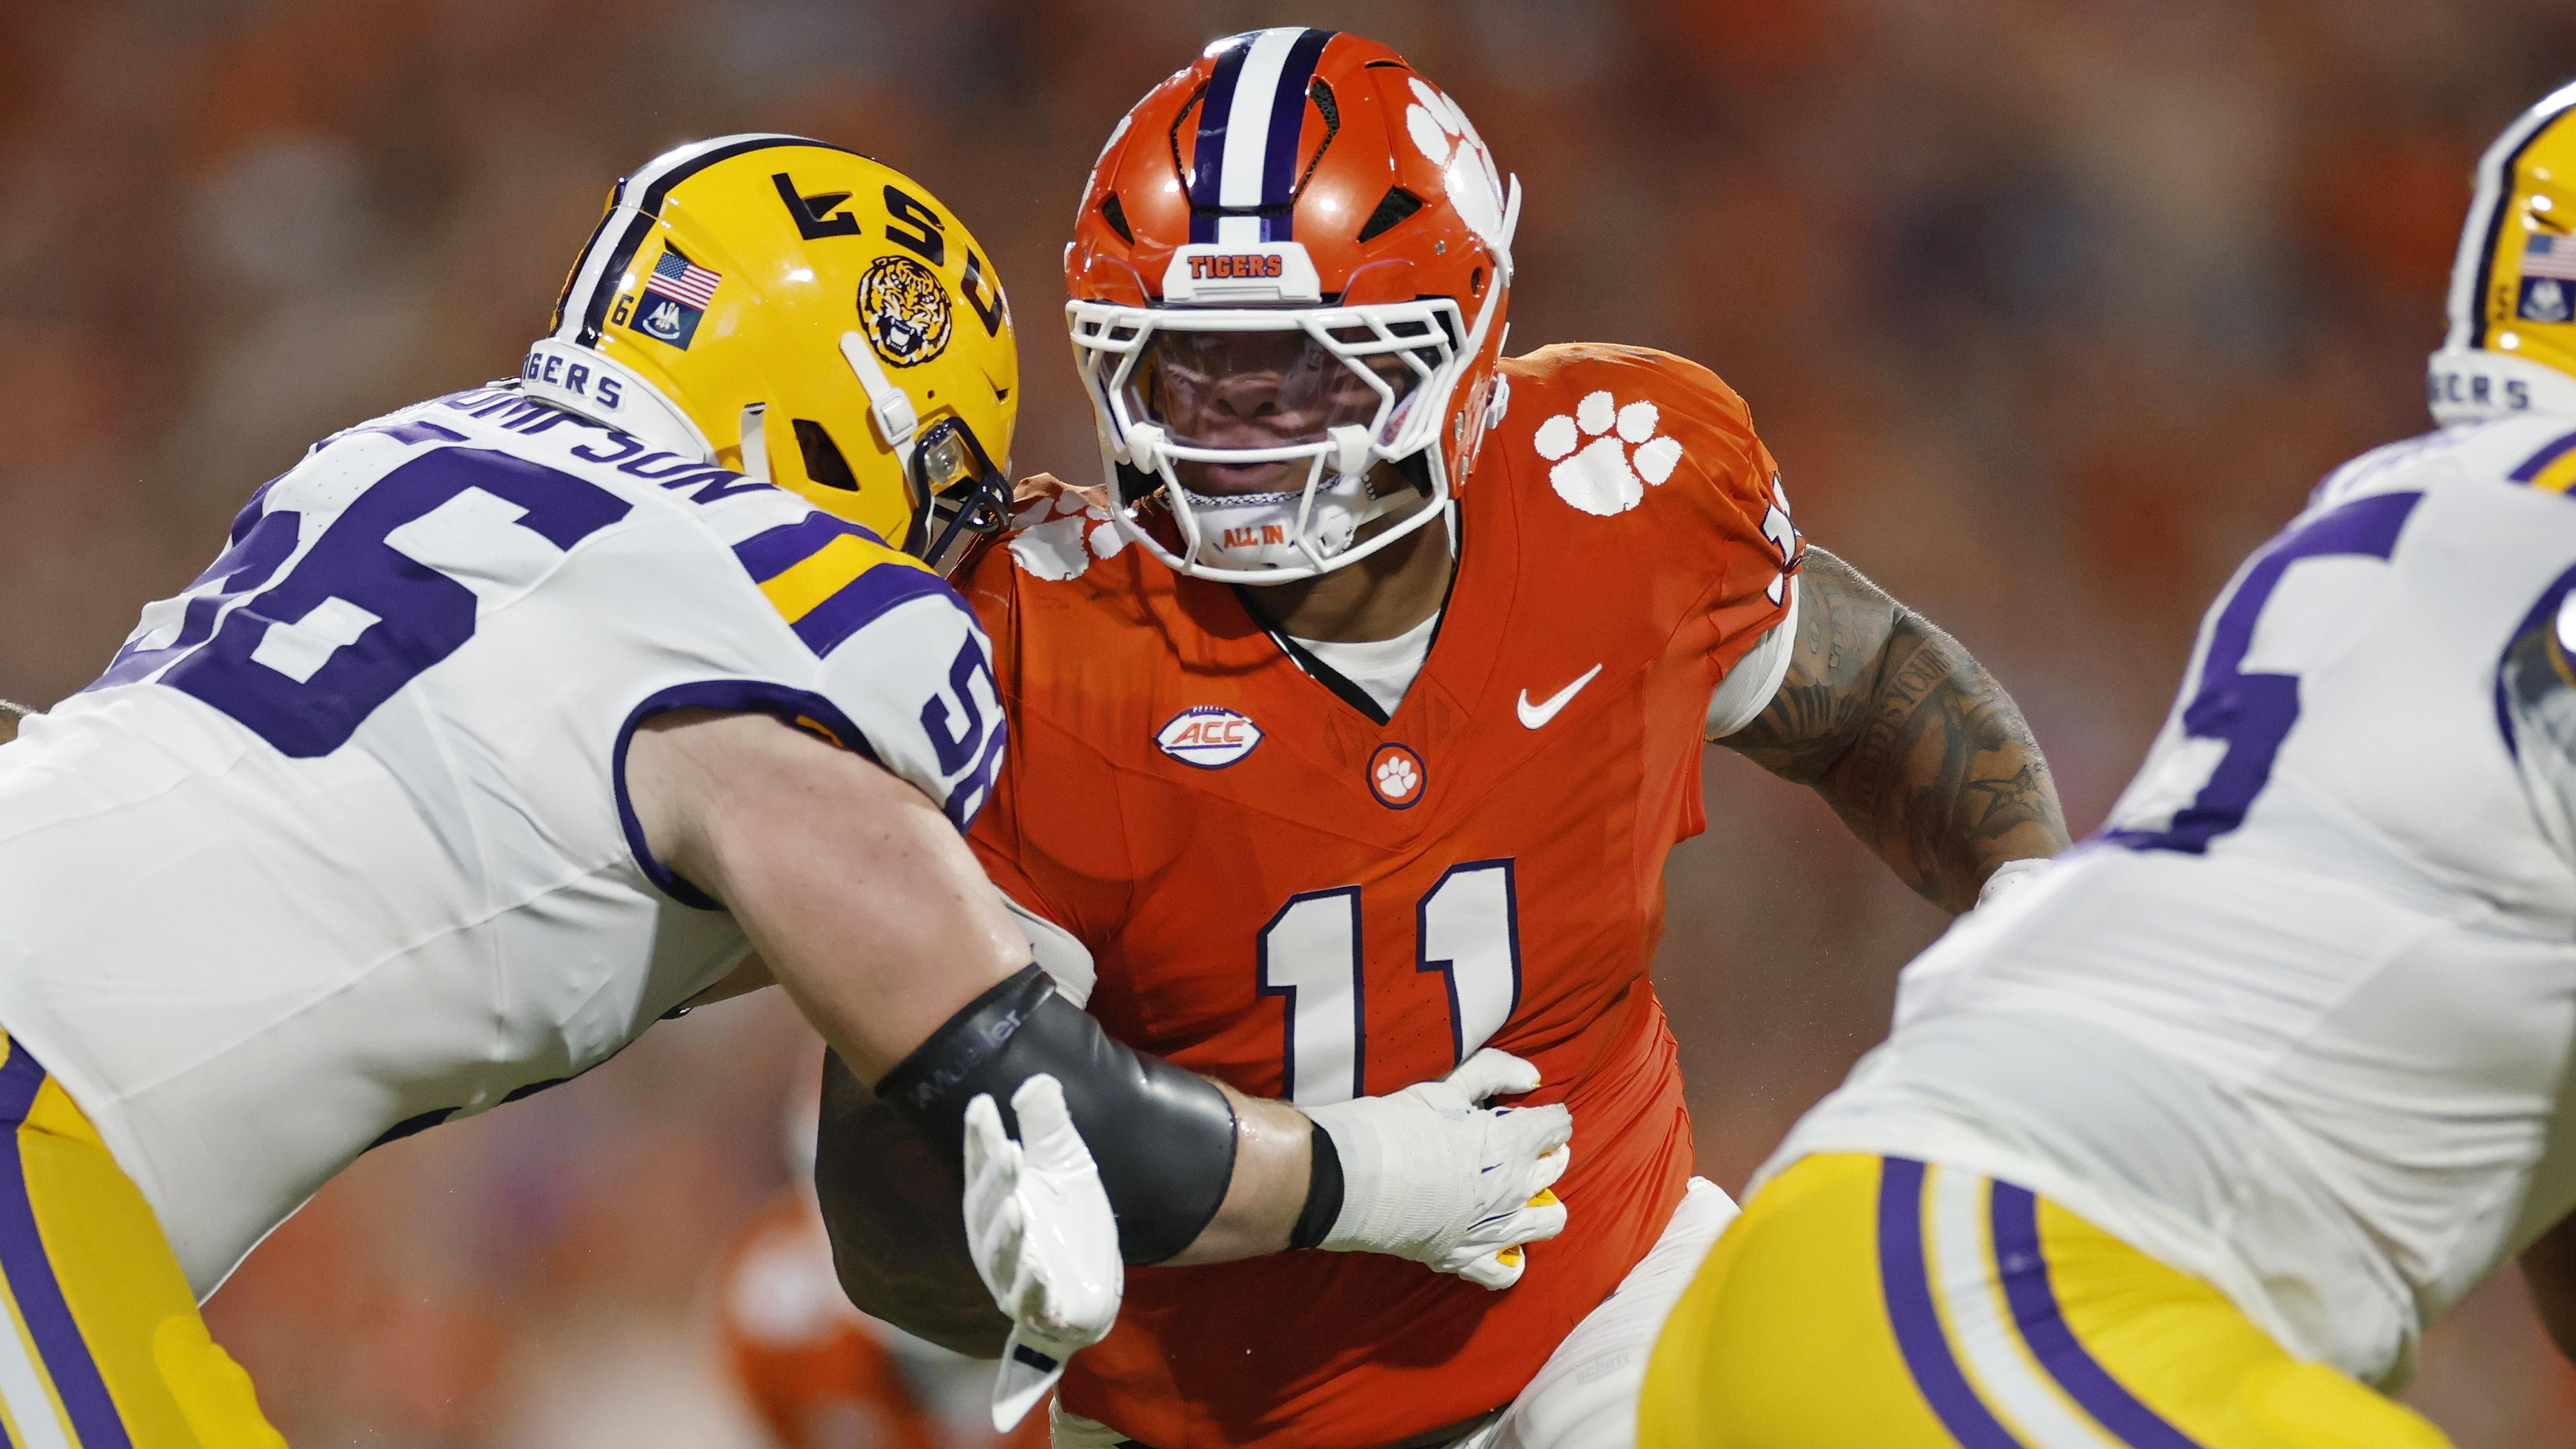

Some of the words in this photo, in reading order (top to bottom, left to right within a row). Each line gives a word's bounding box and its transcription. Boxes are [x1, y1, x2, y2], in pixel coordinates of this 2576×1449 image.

[1187, 254, 1282, 279] TIGERS
[611, 294, 634, 326] 6
[1224, 528, 1258, 548] ALL
[1262, 525, 1284, 545] IN
[1170, 720, 1245, 744] ACC
[1257, 857, 1521, 1105] 11
